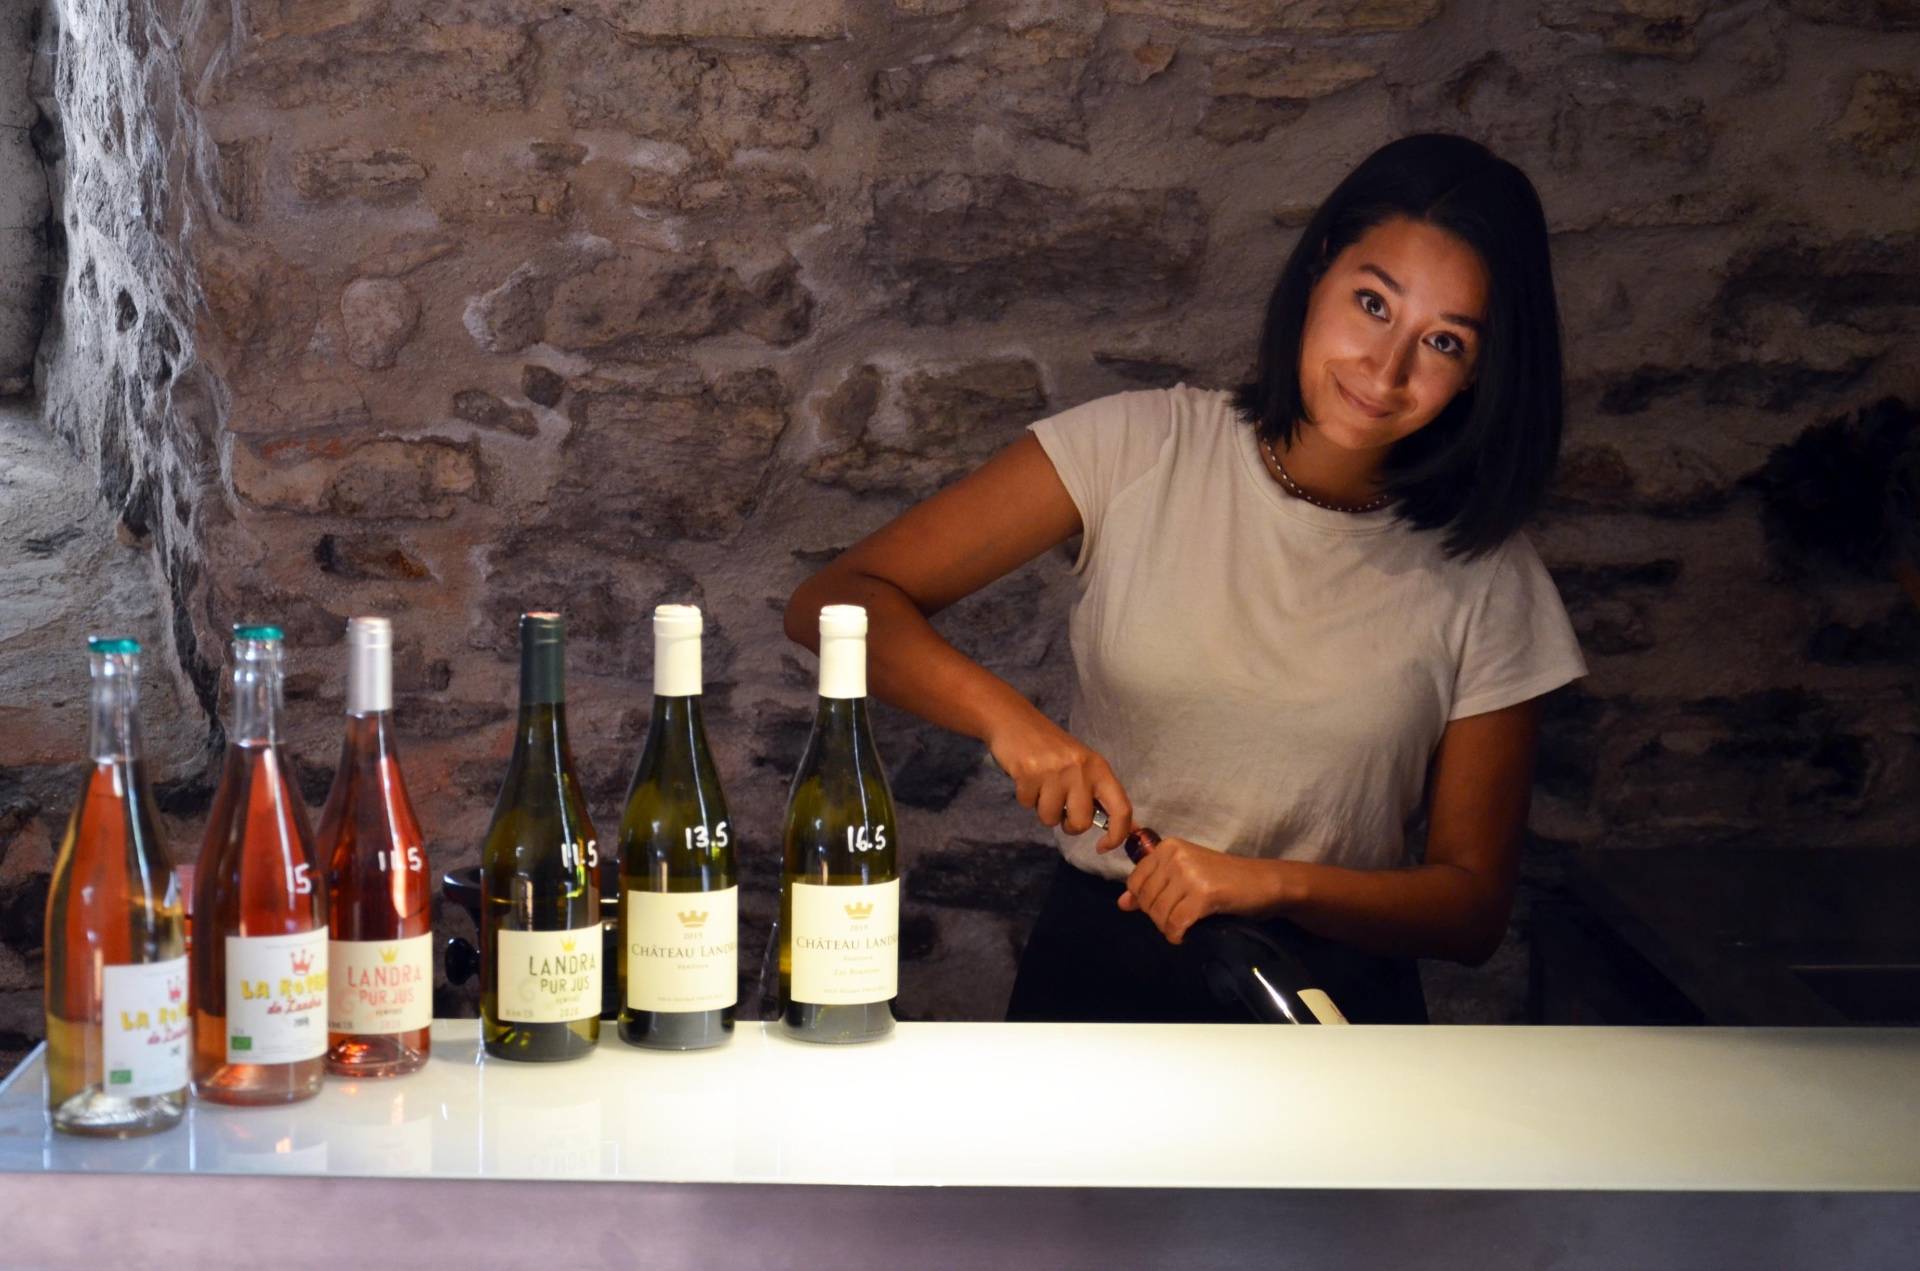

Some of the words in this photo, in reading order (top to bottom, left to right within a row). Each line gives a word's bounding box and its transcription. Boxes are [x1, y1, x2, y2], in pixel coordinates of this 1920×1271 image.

[685, 821, 729, 850] 13.5
[847, 825, 886, 853] 16.5
[286, 863, 312, 894] 15
[631, 943, 695, 959] CHÂTEAU
[796, 936, 860, 951] CHÂTEAU
[528, 953, 596, 977] LANDRA
[347, 965, 424, 988] LANDRA
[540, 978, 566, 995] PUR
[571, 976, 590, 992] JUS
[240, 979, 270, 1000] LA
[359, 989, 387, 1007] PUR
[391, 988, 415, 1004] JUS
